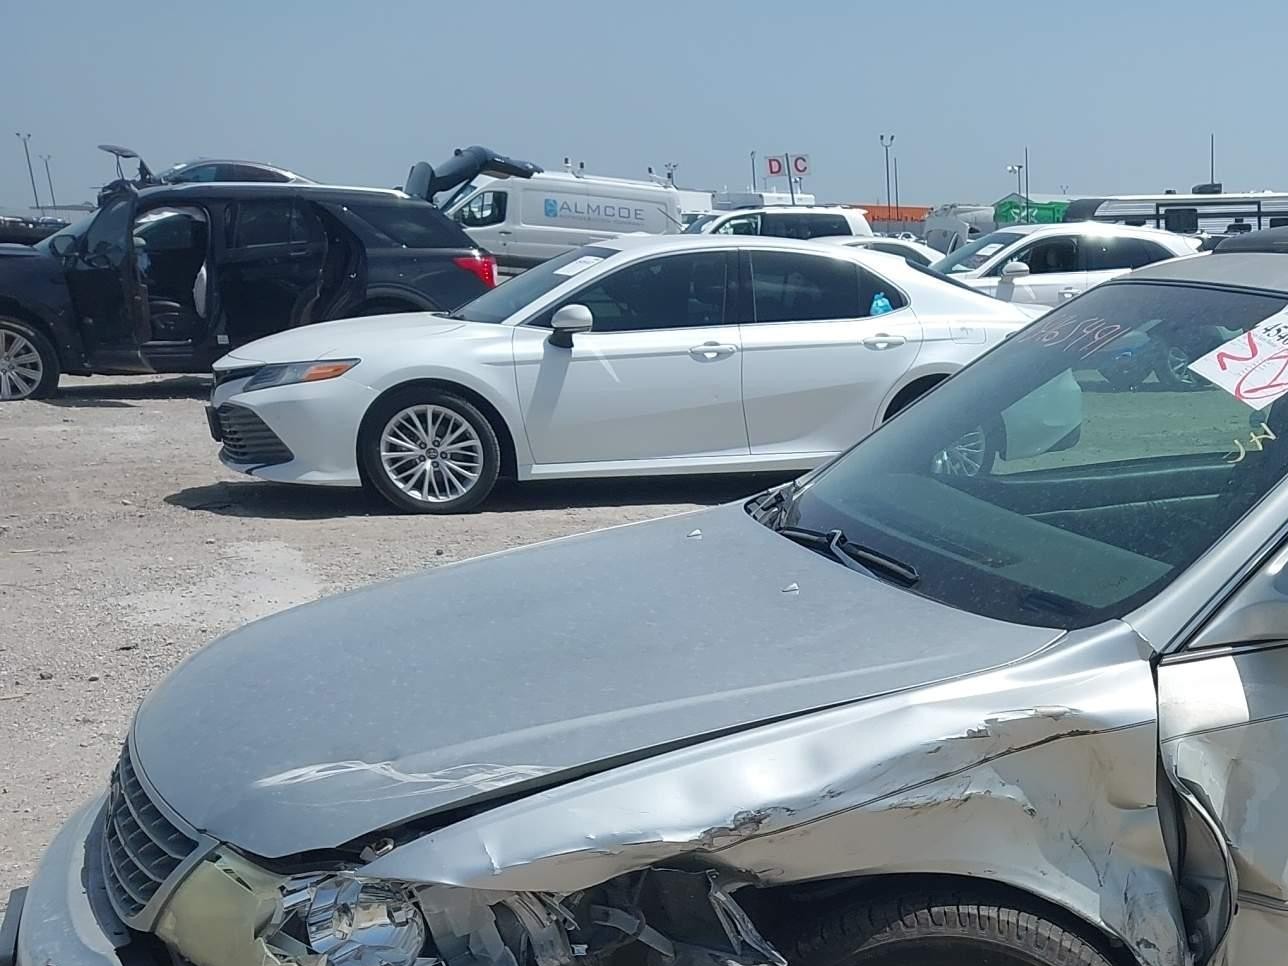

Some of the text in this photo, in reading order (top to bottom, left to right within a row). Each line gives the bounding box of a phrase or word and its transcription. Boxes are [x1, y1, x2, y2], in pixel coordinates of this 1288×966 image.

[768, 158, 782, 175] D
[794, 156, 808, 174] C
[559, 200, 645, 221] ALMCOE
